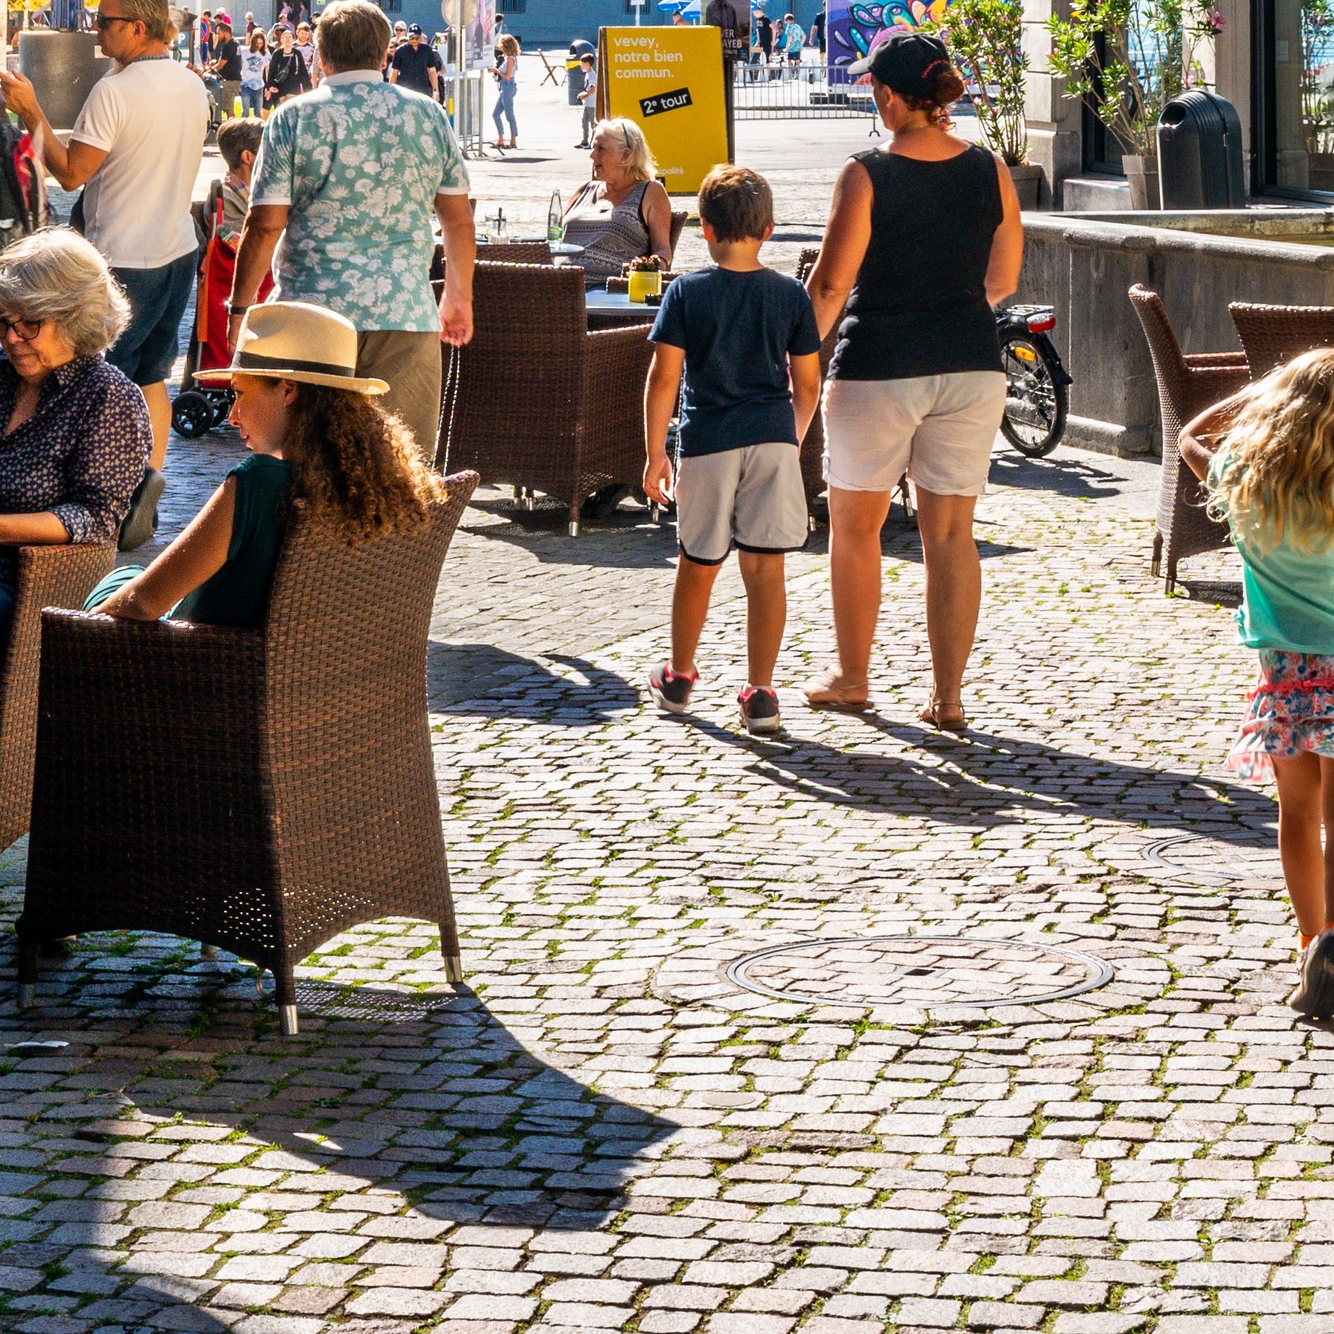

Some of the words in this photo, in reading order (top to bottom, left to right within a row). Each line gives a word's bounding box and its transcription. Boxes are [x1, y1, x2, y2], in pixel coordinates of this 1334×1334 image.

[614, 37, 659, 49] vevey,
[723, 39, 743, 49] AYEB
[614, 51, 650, 63] notre
[654, 50, 683, 62] bien
[615, 68, 674, 79] commun.
[660, 93, 688, 109] tour
